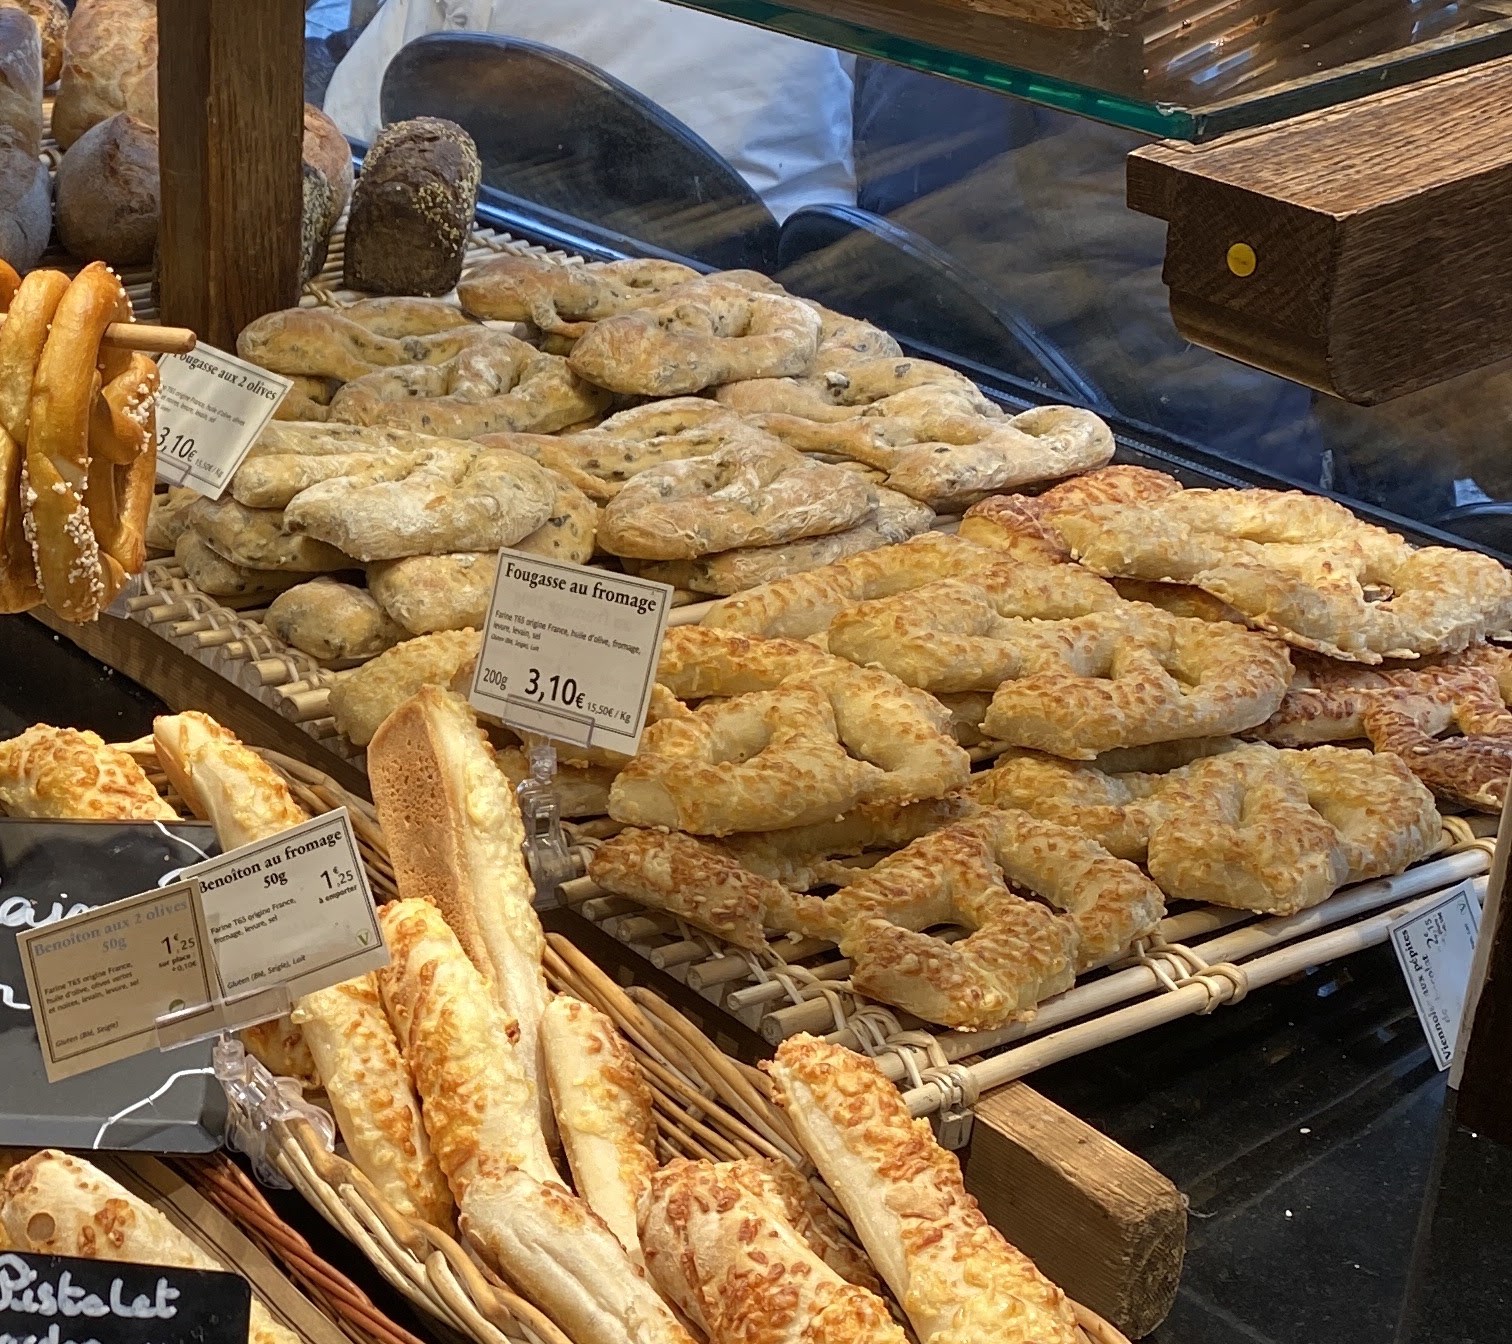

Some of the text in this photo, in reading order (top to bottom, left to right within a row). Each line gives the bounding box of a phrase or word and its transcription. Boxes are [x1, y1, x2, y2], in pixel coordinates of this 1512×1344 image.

[218, 369, 238, 384] aux
[238, 376, 247, 388] 2
[247, 381, 277, 401] olives
[157, 426, 198, 462] 3,10€
[215, 467, 224, 478] Kg
[505, 562, 657, 615] Fougasse au fromage
[496, 610, 513, 621] Farine
[526, 617, 546, 631] origine
[548, 623, 569, 637] France,
[571, 629, 587, 641] huile
[483, 667, 508, 690] 200g
[525, 668, 586, 710] 3,10€
[587, 701, 614, 718] 15,50€
[620, 711, 631, 724] Kg
[200, 830, 342, 894] Benoîton au fromage
[263, 871, 288, 889] 50g
[325, 885, 357, 902] emporter
[33, 899, 187, 957] Benoîton aux 2 olives
[210, 921, 232, 935] Farine
[248, 906, 270, 922] origine
[272, 897, 296, 911] France,
[213, 914, 278, 945] fromage, levure, sel
[102, 936, 128, 954] 50g
[1402, 929, 1420, 972] pépites
[44, 982, 66, 996] Farine
[83, 970, 106, 985] origine
[108, 961, 133, 979] France,
[227, 975, 249, 989] Gluten
[292, 954, 306, 966] Lait
[46, 992, 64, 1005] huile
[90, 979, 110, 991] olives
[49, 1006, 56, 1014] et
[129, 979, 139, 990] sel
[55, 1035, 78, 1048] Gluten
